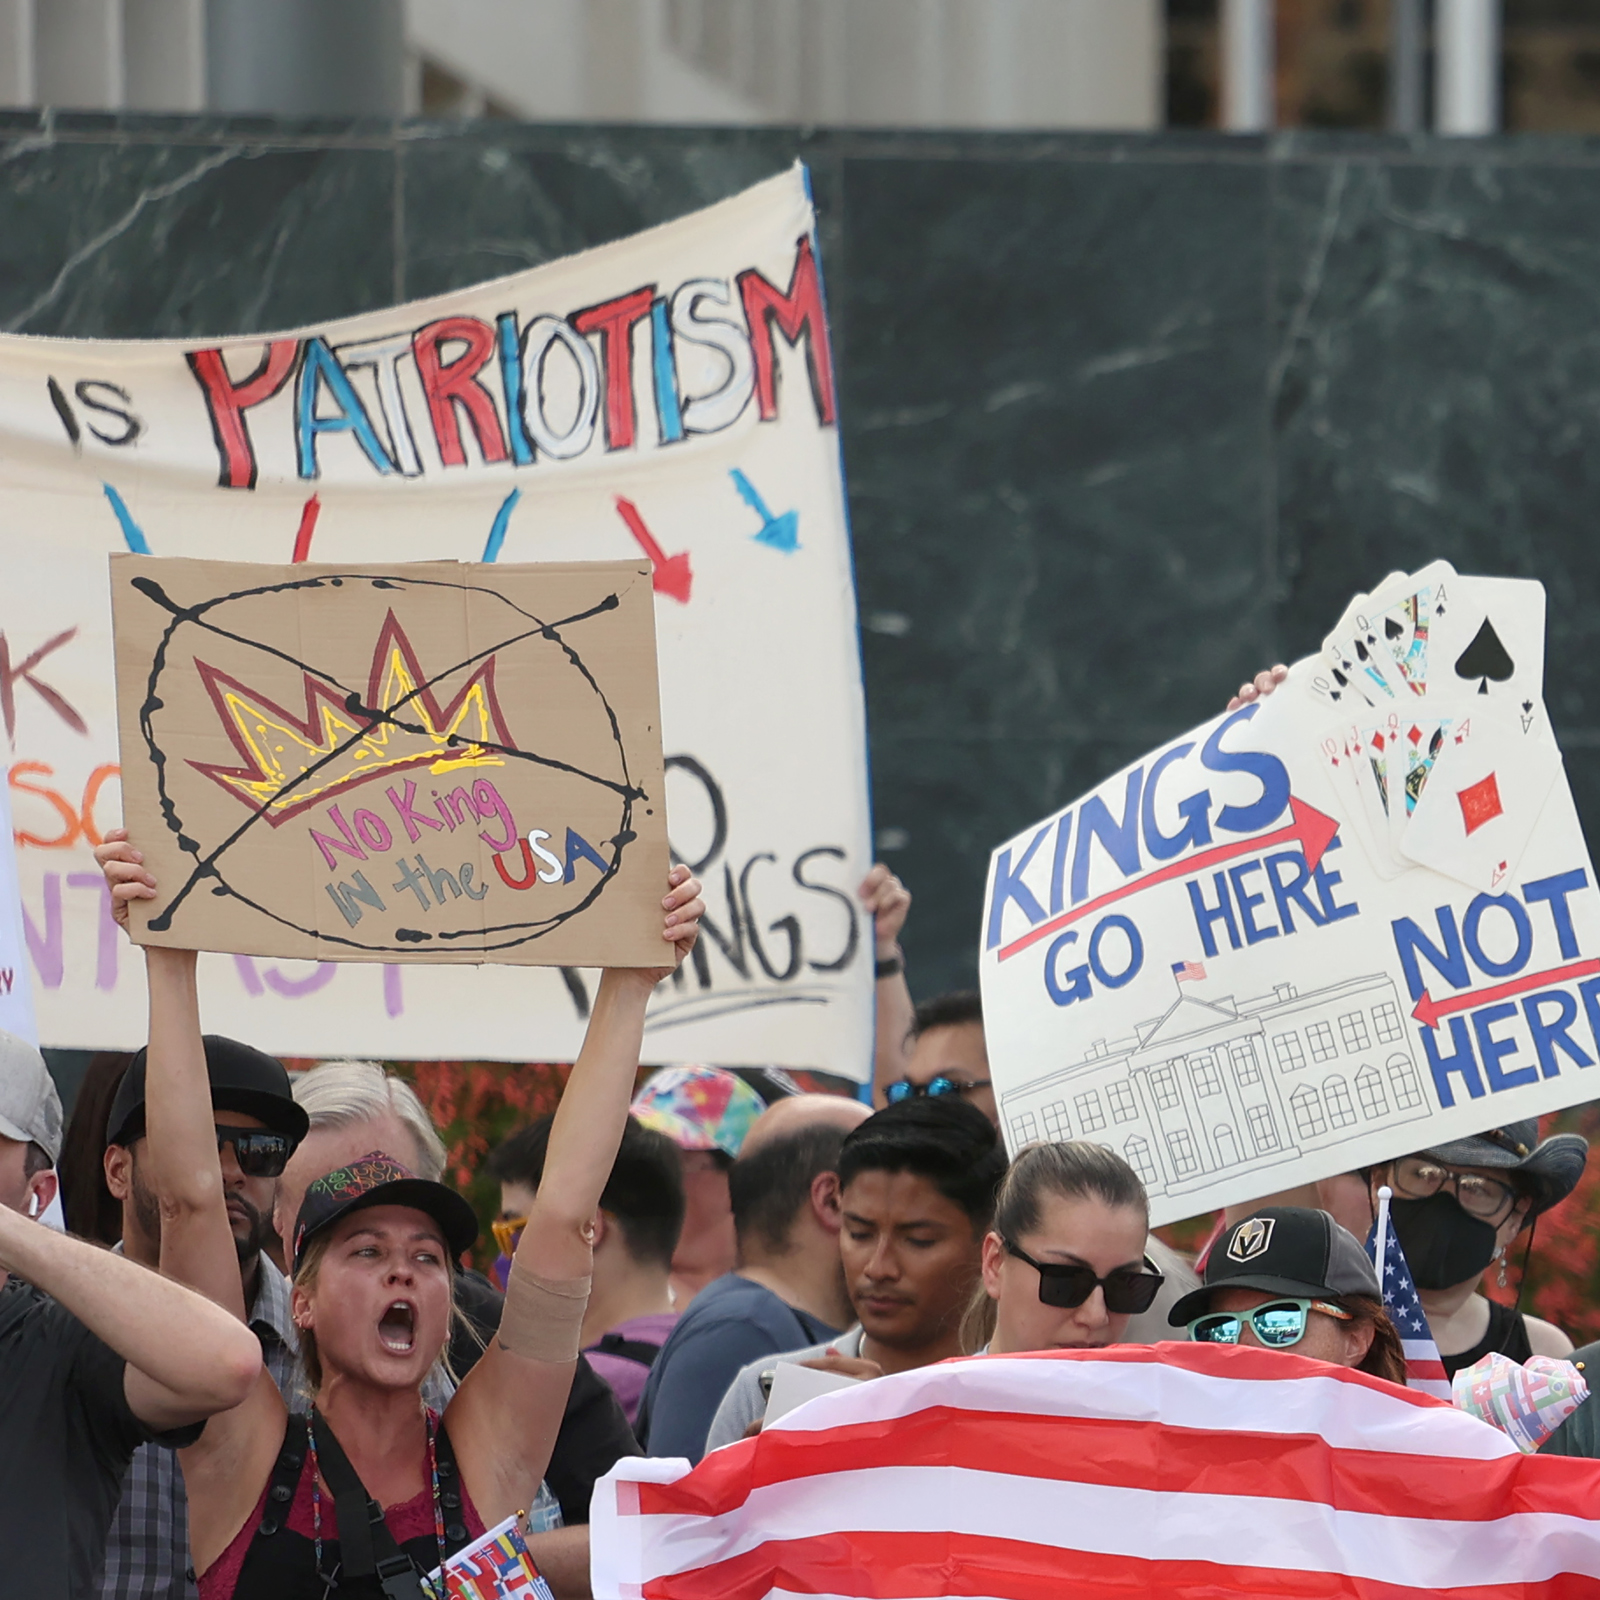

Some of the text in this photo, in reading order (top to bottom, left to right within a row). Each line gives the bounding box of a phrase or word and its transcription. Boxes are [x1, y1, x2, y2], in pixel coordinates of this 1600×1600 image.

[47, 374, 143, 452] IS
[309, 778, 518, 871] No King
[393, 854, 489, 911] the
[492, 826, 609, 890] USA
[986, 703, 1293, 951] KINGS
[1044, 834, 1360, 1007] GO HERE
[1392, 868, 1590, 1001] NOT
